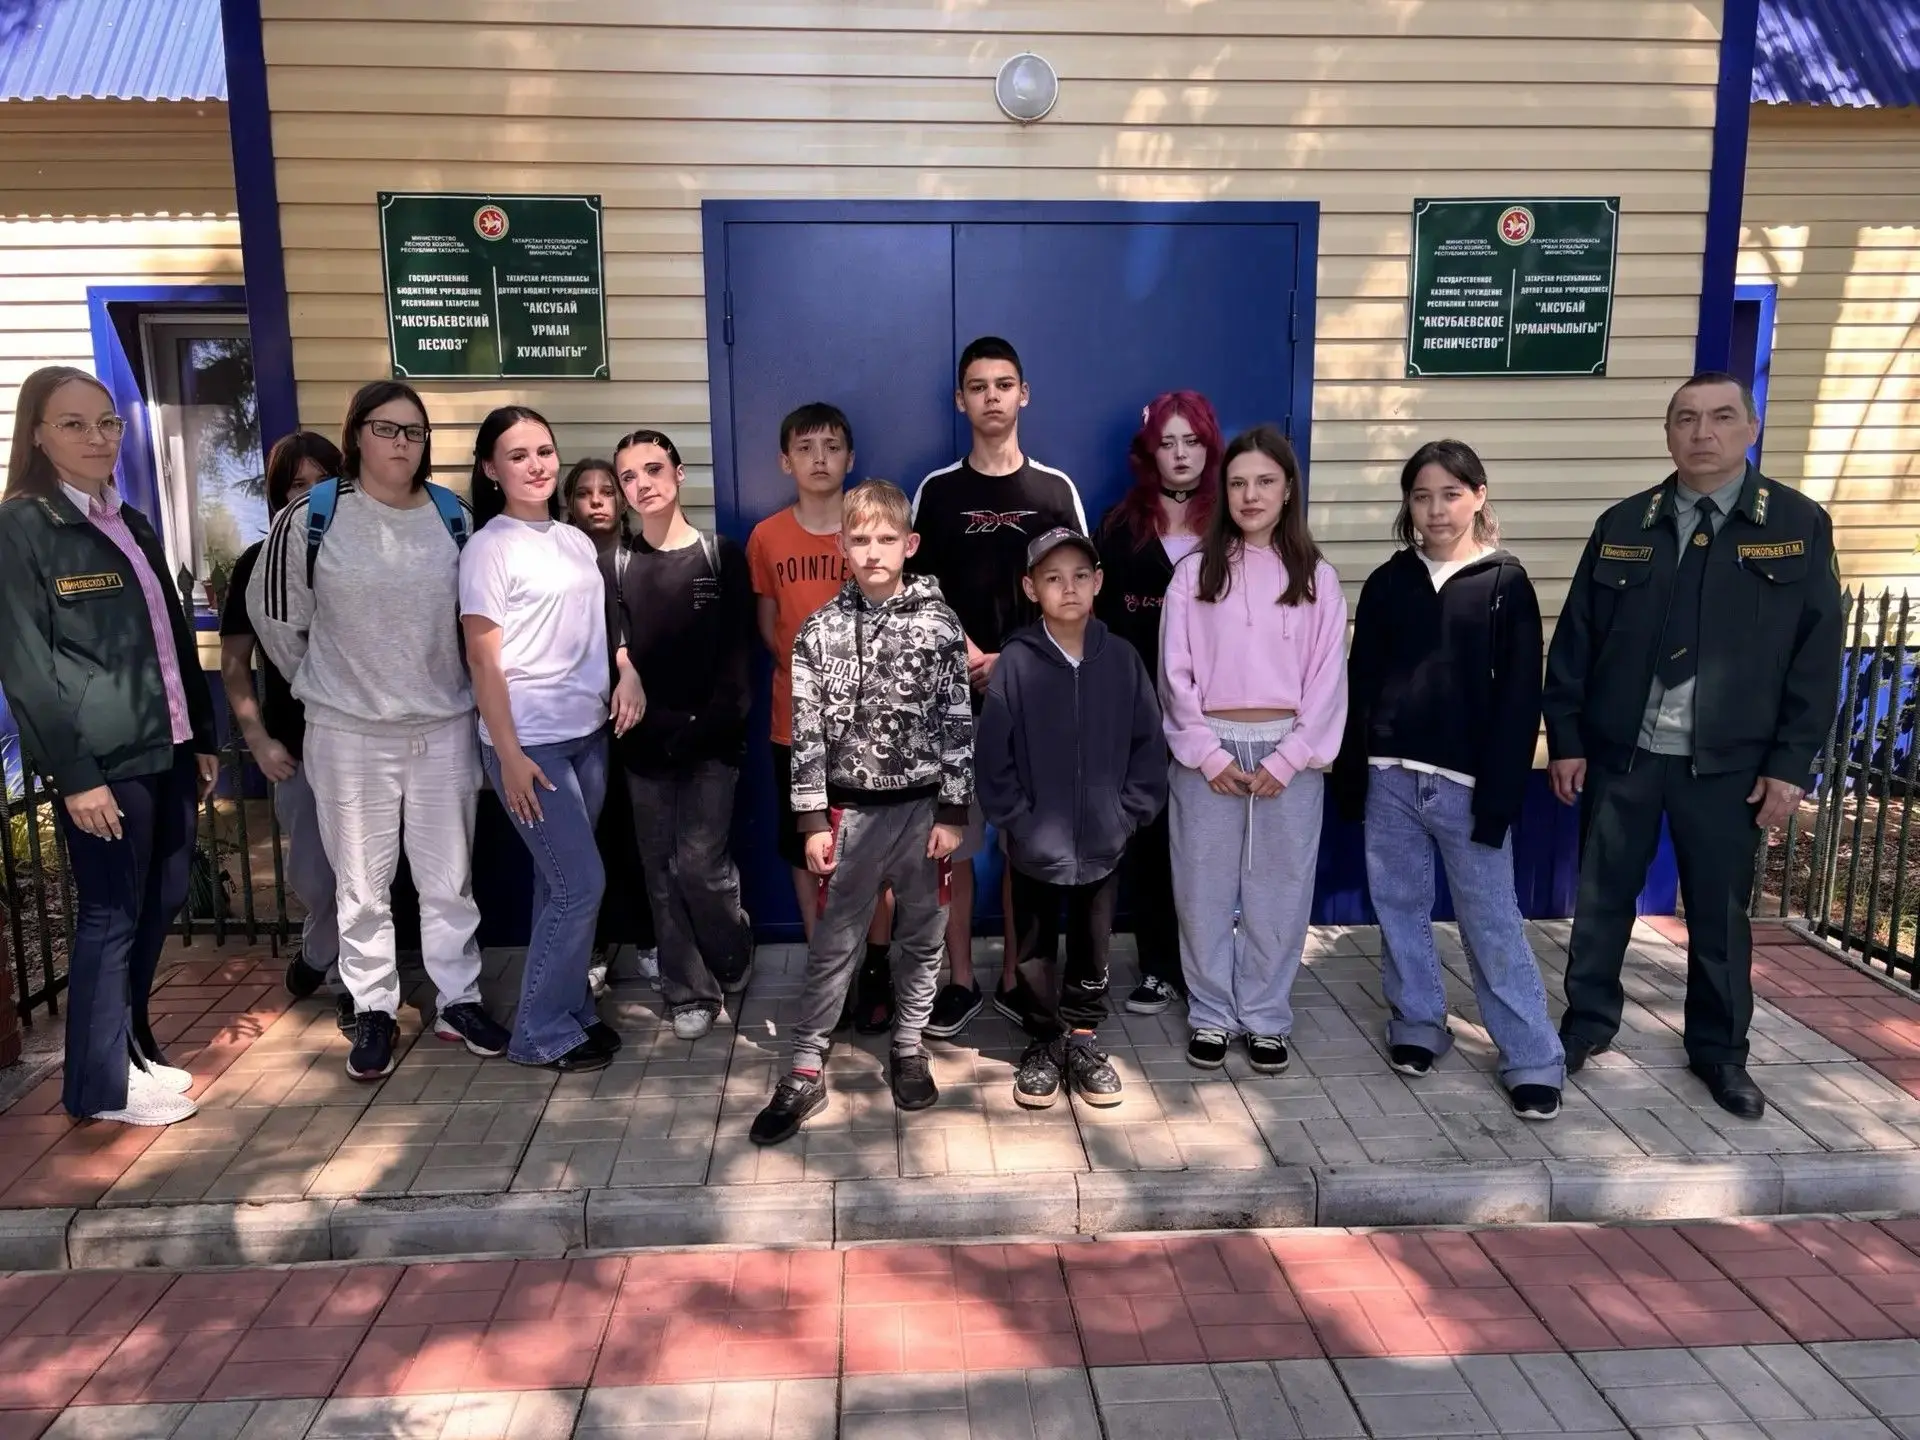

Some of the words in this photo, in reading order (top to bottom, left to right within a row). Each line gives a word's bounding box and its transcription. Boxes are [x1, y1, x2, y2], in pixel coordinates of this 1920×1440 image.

[409, 275, 469, 283] ГОСУДАРСТВЕННОЕ
[397, 287, 437, 295] БЮДЖЕТНОЕ
[532, 325, 570, 335] УРМАН
[1741, 546, 1784, 557] ПРОКОПЬЕВ
[106, 576, 118, 585] РТ
[872, 775, 906, 788] GOAL
